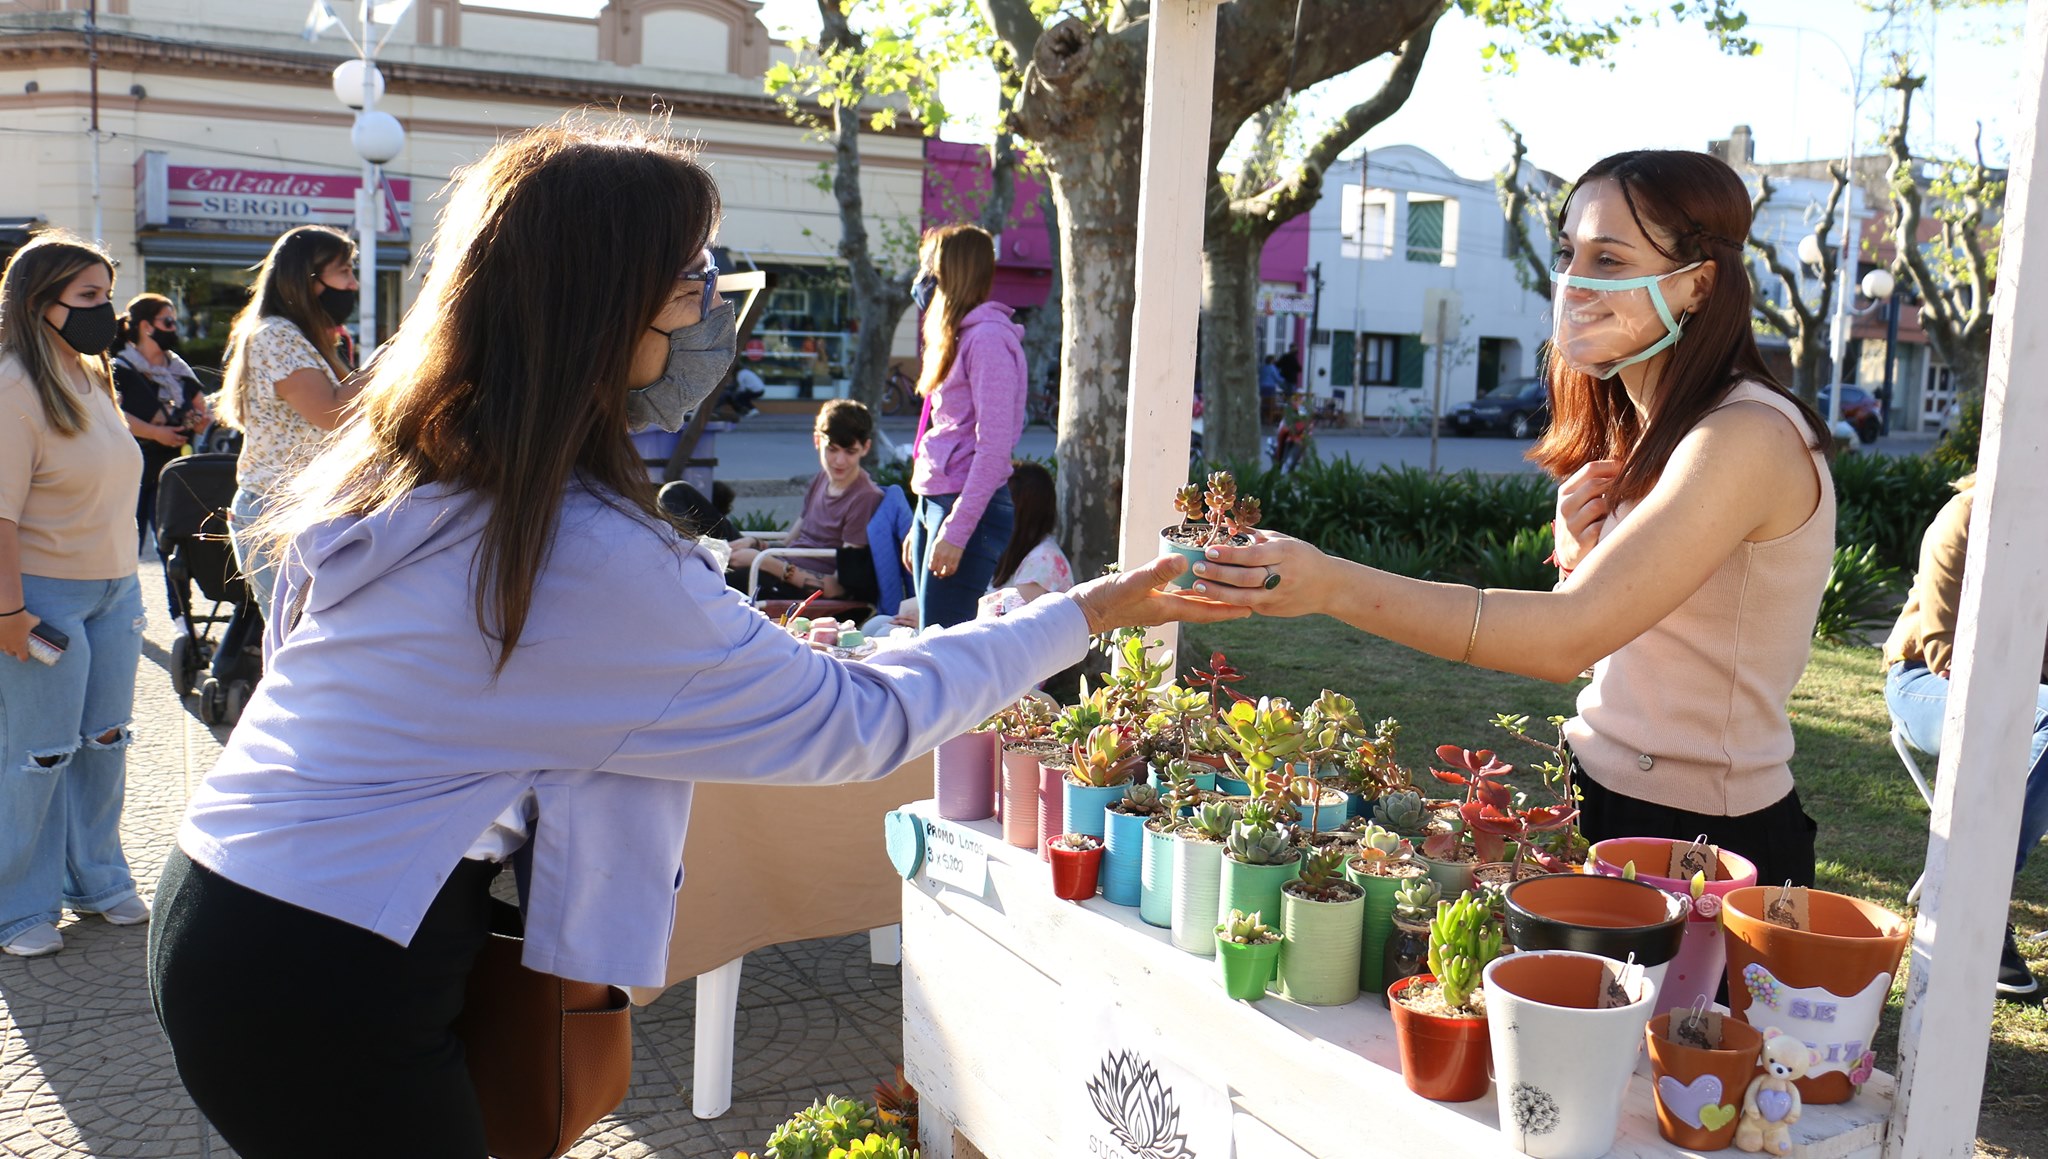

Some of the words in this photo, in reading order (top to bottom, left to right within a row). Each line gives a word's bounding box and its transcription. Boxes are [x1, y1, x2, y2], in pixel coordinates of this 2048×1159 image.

[187, 169, 325, 196] Calzados
[203, 198, 309, 216] SERGIO
[927, 823, 954, 845] PROMO
[927, 846, 934, 863] 3
[1788, 998, 1837, 1023] SE
